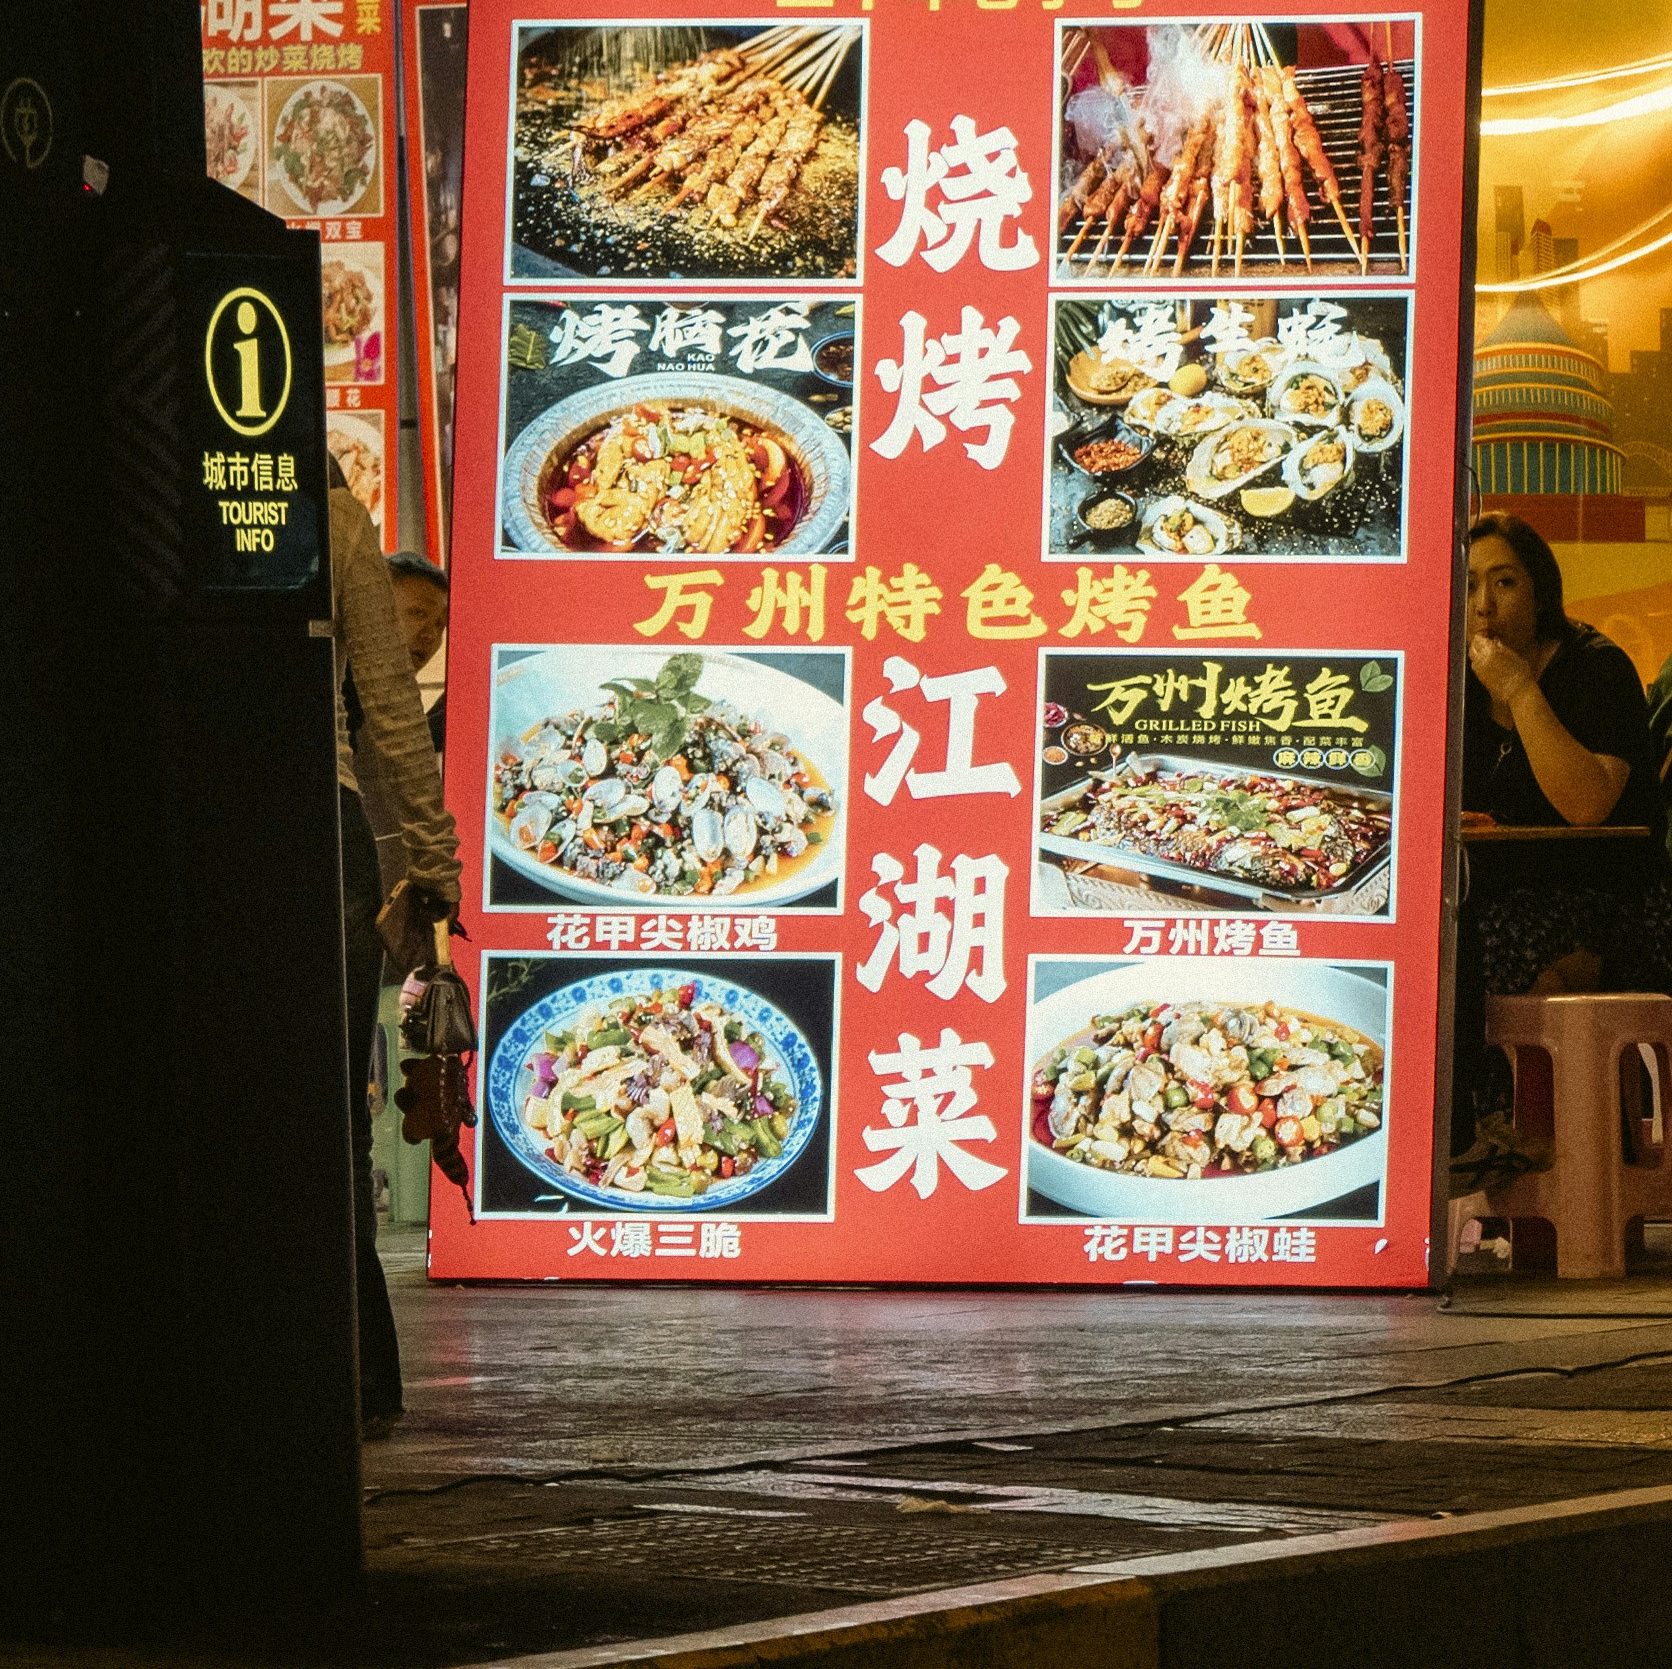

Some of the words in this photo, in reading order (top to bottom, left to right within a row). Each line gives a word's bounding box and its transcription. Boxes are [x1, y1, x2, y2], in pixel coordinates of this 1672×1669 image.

[869, 114, 1040, 470] 烧烤
[550, 301, 815, 378] 烤脑花
[687, 353, 715, 363] KAO
[657, 362, 685, 372] NAO
[687, 362, 716, 372] HUA
[202, 451, 298, 492] 城市信息
[219, 500, 289, 526] TOURIST
[236, 528, 275, 552] INFO
[633, 563, 1263, 643] 万州特色烤鱼
[1086, 661, 1369, 732] 万州烤鱼
[1134, 719, 1217, 733] GRILLED
[1220, 719, 1261, 733] FISH
[546, 914, 778, 951] 花甲尖椒鸡
[853, 655, 1022, 1200] 江湖菜
[1122, 919, 1302, 958] 万州烤鱼
[567, 1221, 742, 1259] 火爆三脆
[1082, 1224, 1318, 1264] 花甲尖椒蛙
